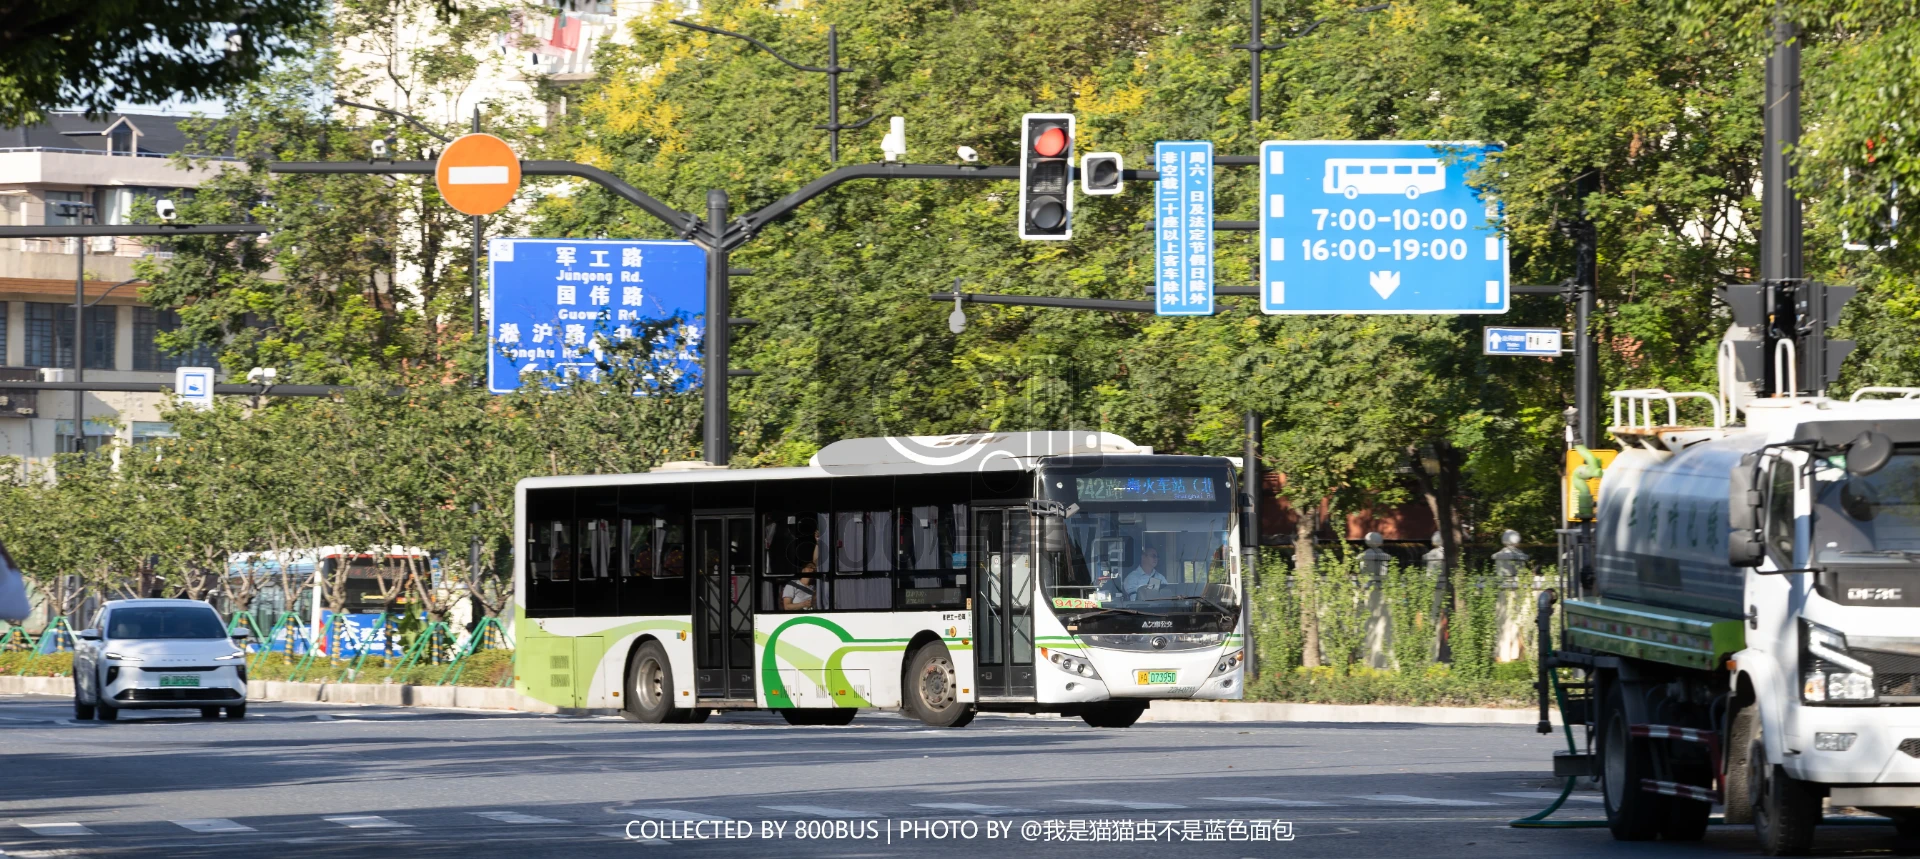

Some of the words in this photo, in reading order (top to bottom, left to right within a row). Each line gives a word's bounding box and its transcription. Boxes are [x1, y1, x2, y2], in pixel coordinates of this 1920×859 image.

[1161, 151, 1180, 306] 非空载二十座以上客车除外
[1188, 151, 1207, 305] 周六、日及法定节假日除外
[1311, 208, 1468, 231] 7:00-10:00
[555, 246, 644, 268] 军工路
[1302, 238, 1468, 261] 16:00-19:00
[555, 270, 613, 284] Jungong
[620, 270, 644, 283] Rd.
[556, 285, 644, 306] 国伟路
[617, 309, 641, 321] Rd.
